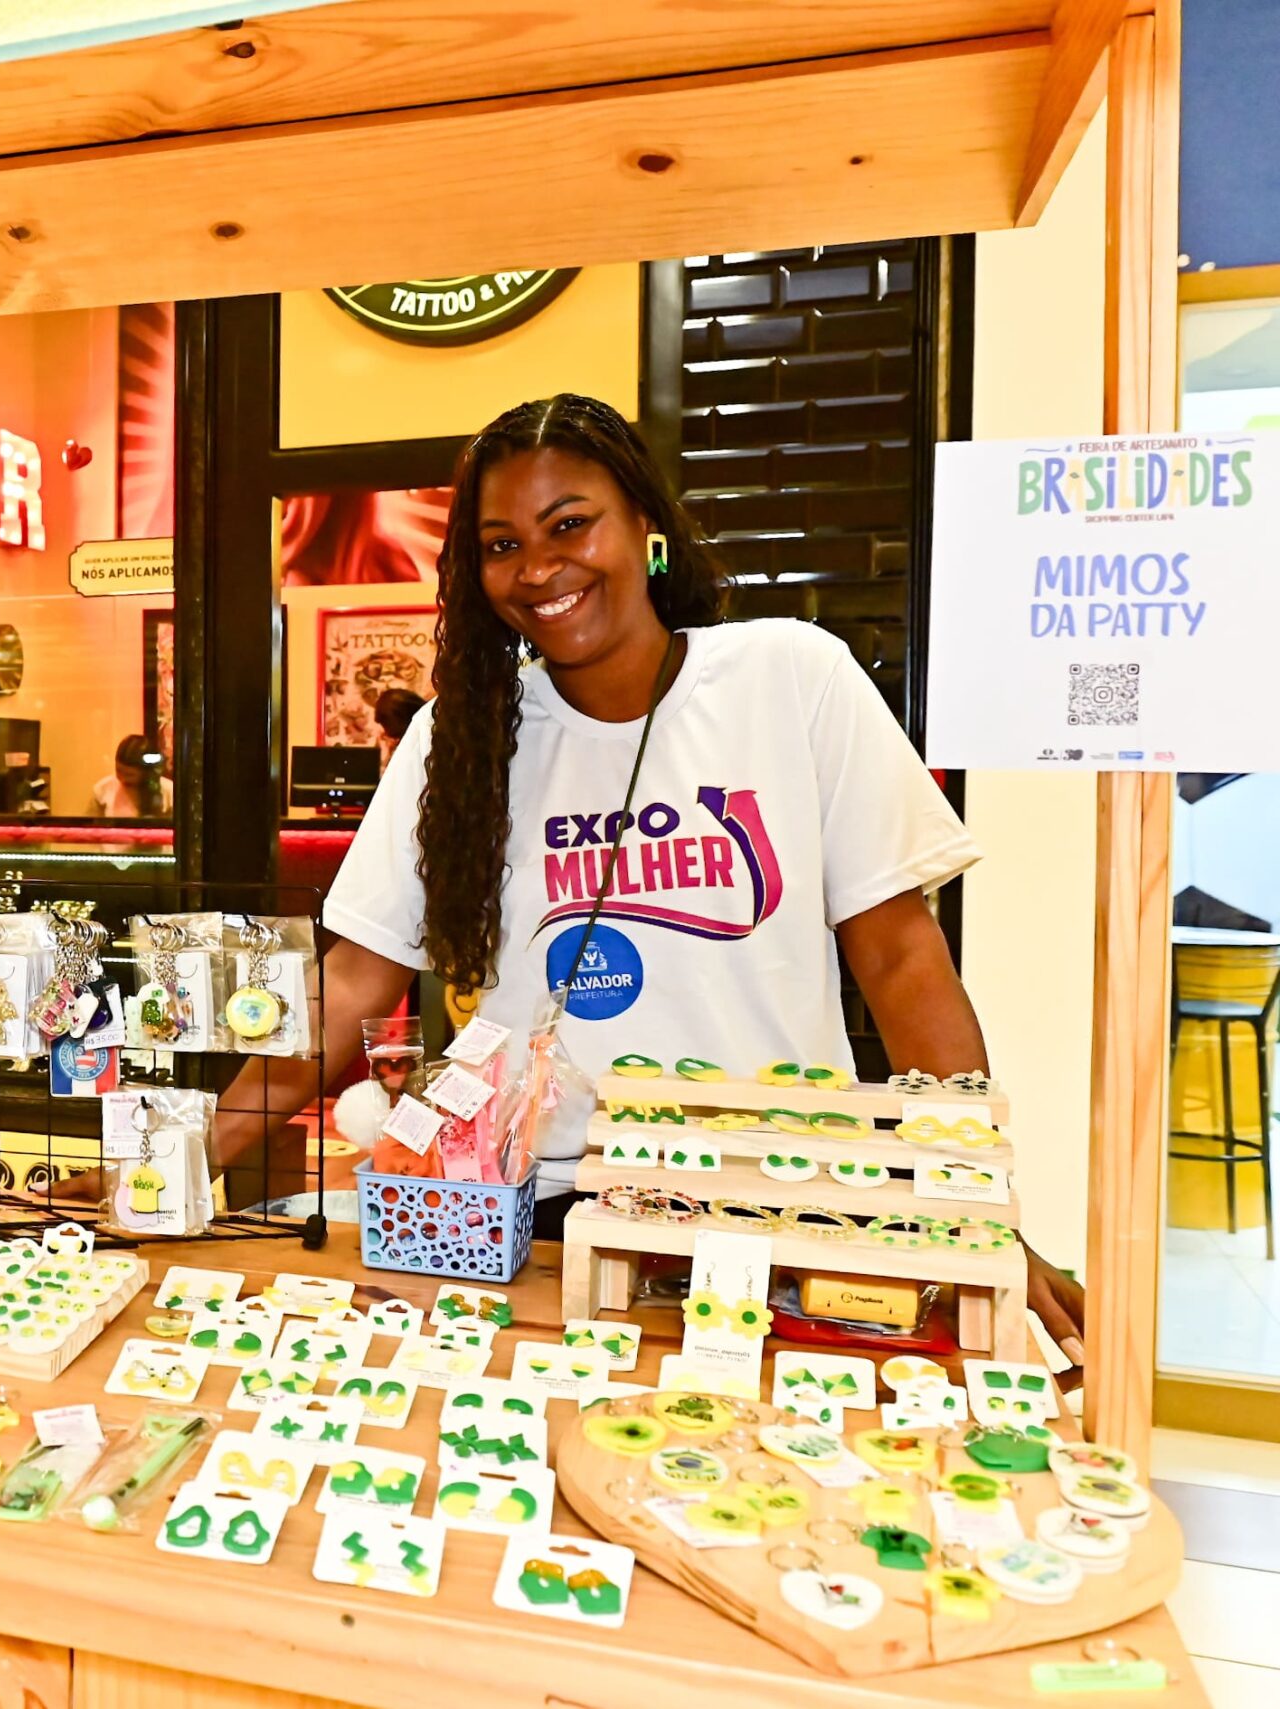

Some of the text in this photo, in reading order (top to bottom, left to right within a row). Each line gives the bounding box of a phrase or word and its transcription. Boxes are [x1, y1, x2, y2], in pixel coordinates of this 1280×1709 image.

[390, 287, 476, 317] TATTOO
[479, 284, 495, 301] &
[1078, 438, 1198, 454] FEIRA DE ARTESANATO
[82, 565, 105, 580] NÓS
[1034, 552, 1190, 597] MIMOS
[1030, 602, 1207, 638] DA PATTY
[349, 633, 428, 649] TATTOO
[544, 802, 681, 850] EXPO
[544, 835, 735, 903] MULHER
[554, 973, 634, 993] SALVADOR
